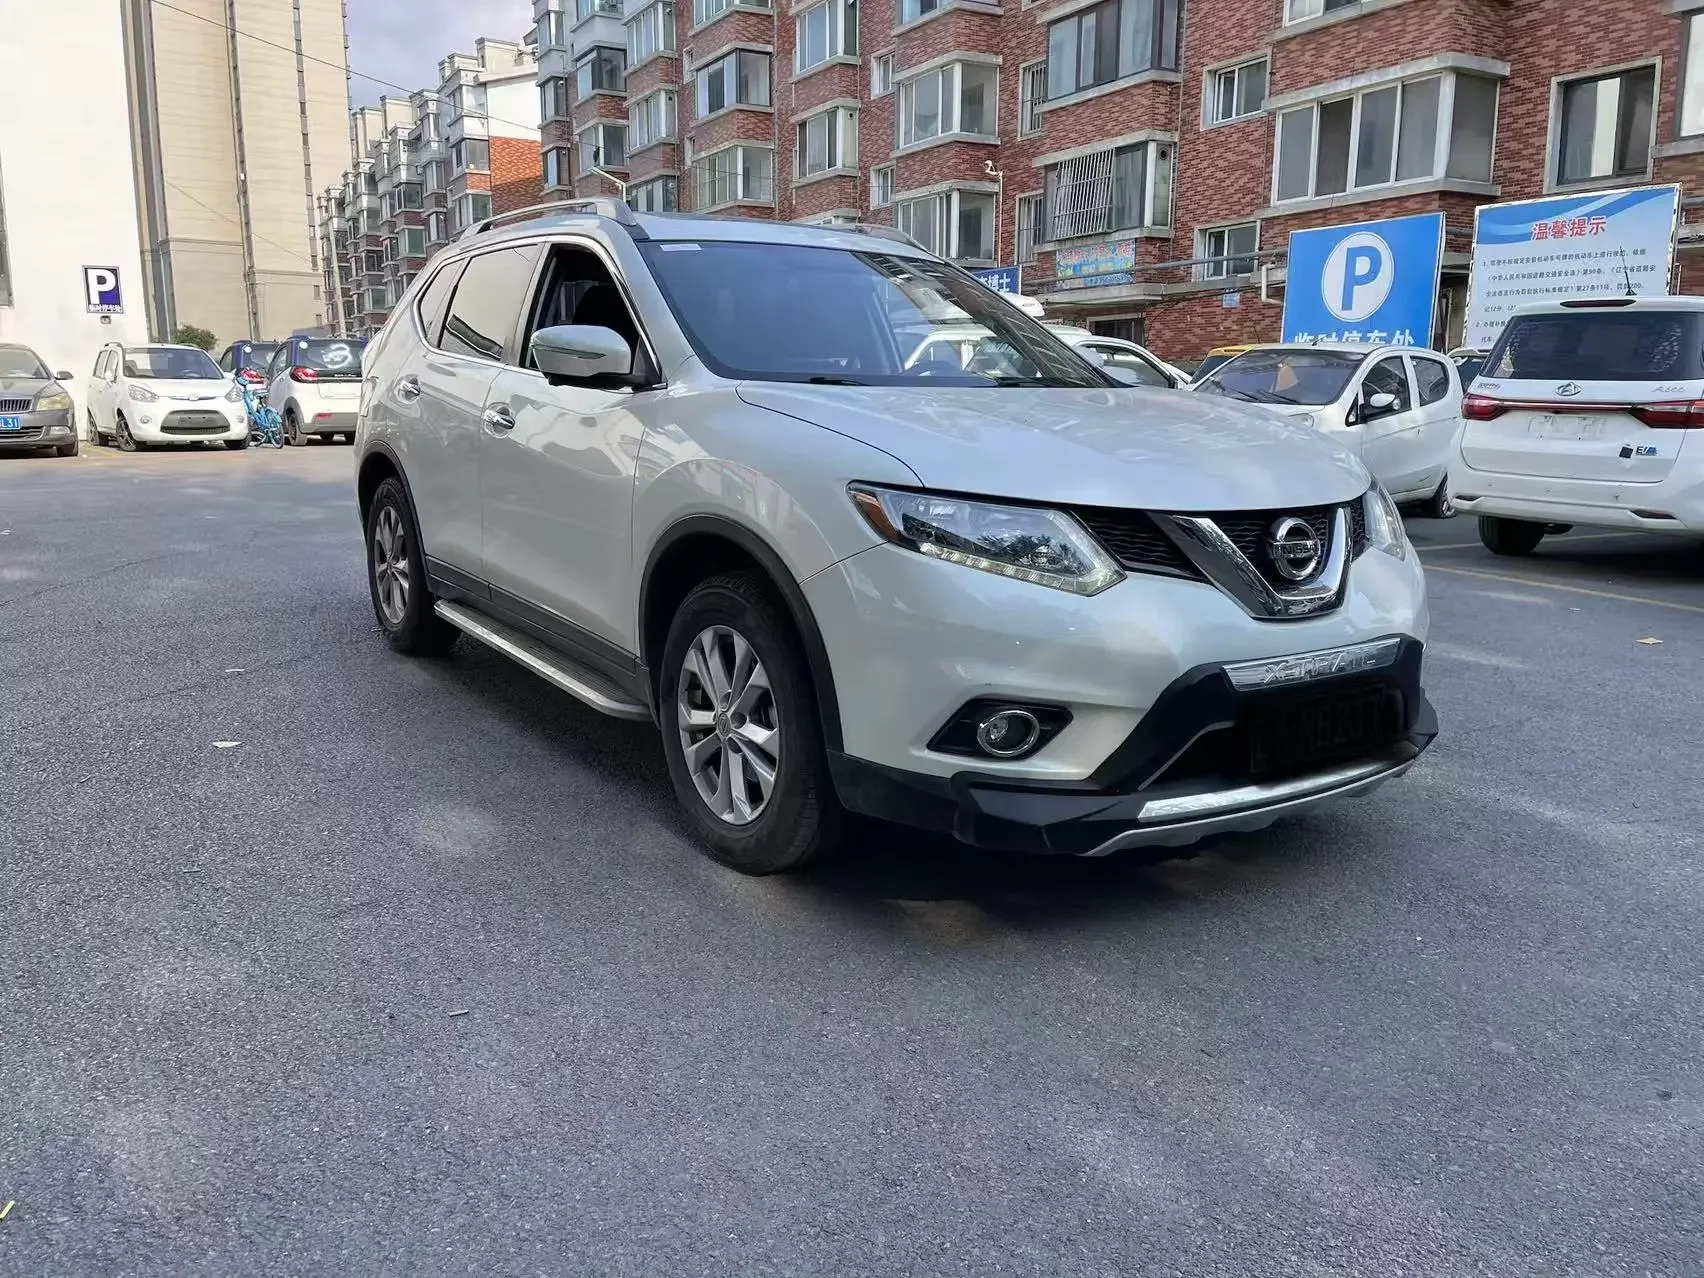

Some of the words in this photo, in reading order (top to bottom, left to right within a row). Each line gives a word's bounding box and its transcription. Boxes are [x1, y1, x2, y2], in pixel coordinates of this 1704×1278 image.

[1531, 216, 1607, 240] 温馨提示
[87, 268, 116, 304] P
[1341, 245, 1383, 311] P
[0, 418, 18, 428] L31
